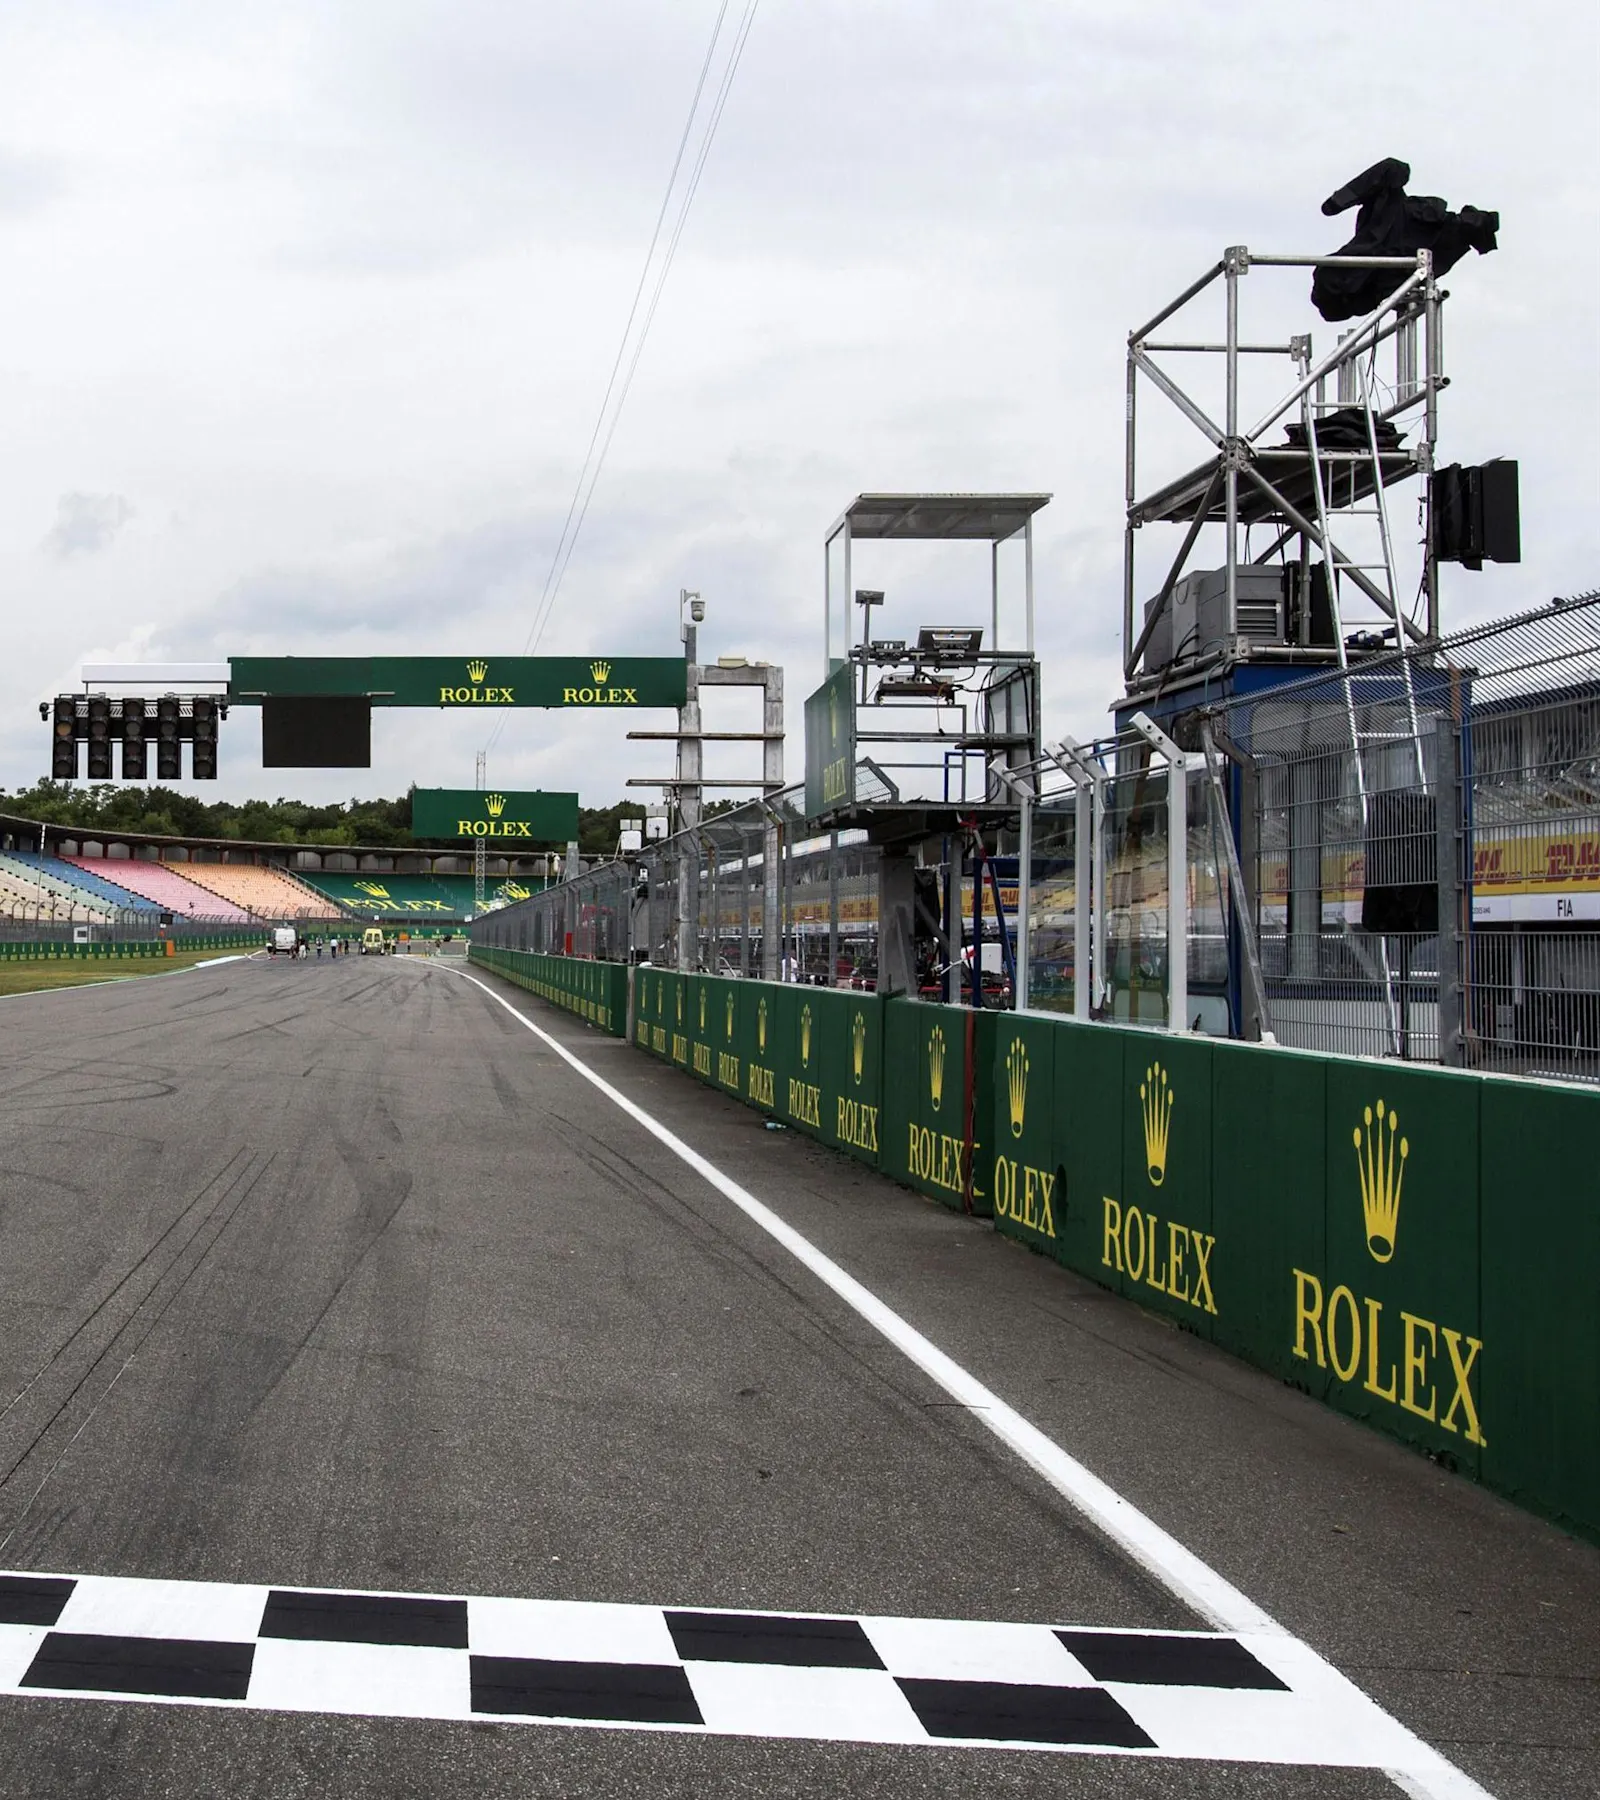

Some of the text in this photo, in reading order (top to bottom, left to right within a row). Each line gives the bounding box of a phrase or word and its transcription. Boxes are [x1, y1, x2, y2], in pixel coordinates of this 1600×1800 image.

[440, 688, 515, 703] ROLEX
[564, 688, 638, 703] ROLEX
[457, 821, 532, 837] ROLEX
[1557, 899, 1573, 917] FIA
[718, 1052, 740, 1090] ROLEX
[749, 1063, 775, 1108] ROLEX
[788, 1078, 820, 1128] ROLEX
[837, 1096, 879, 1152] ROLEX
[1101, 1196, 1218, 1316] ROLEX
[1292, 1267, 1488, 1448] ROLEX
